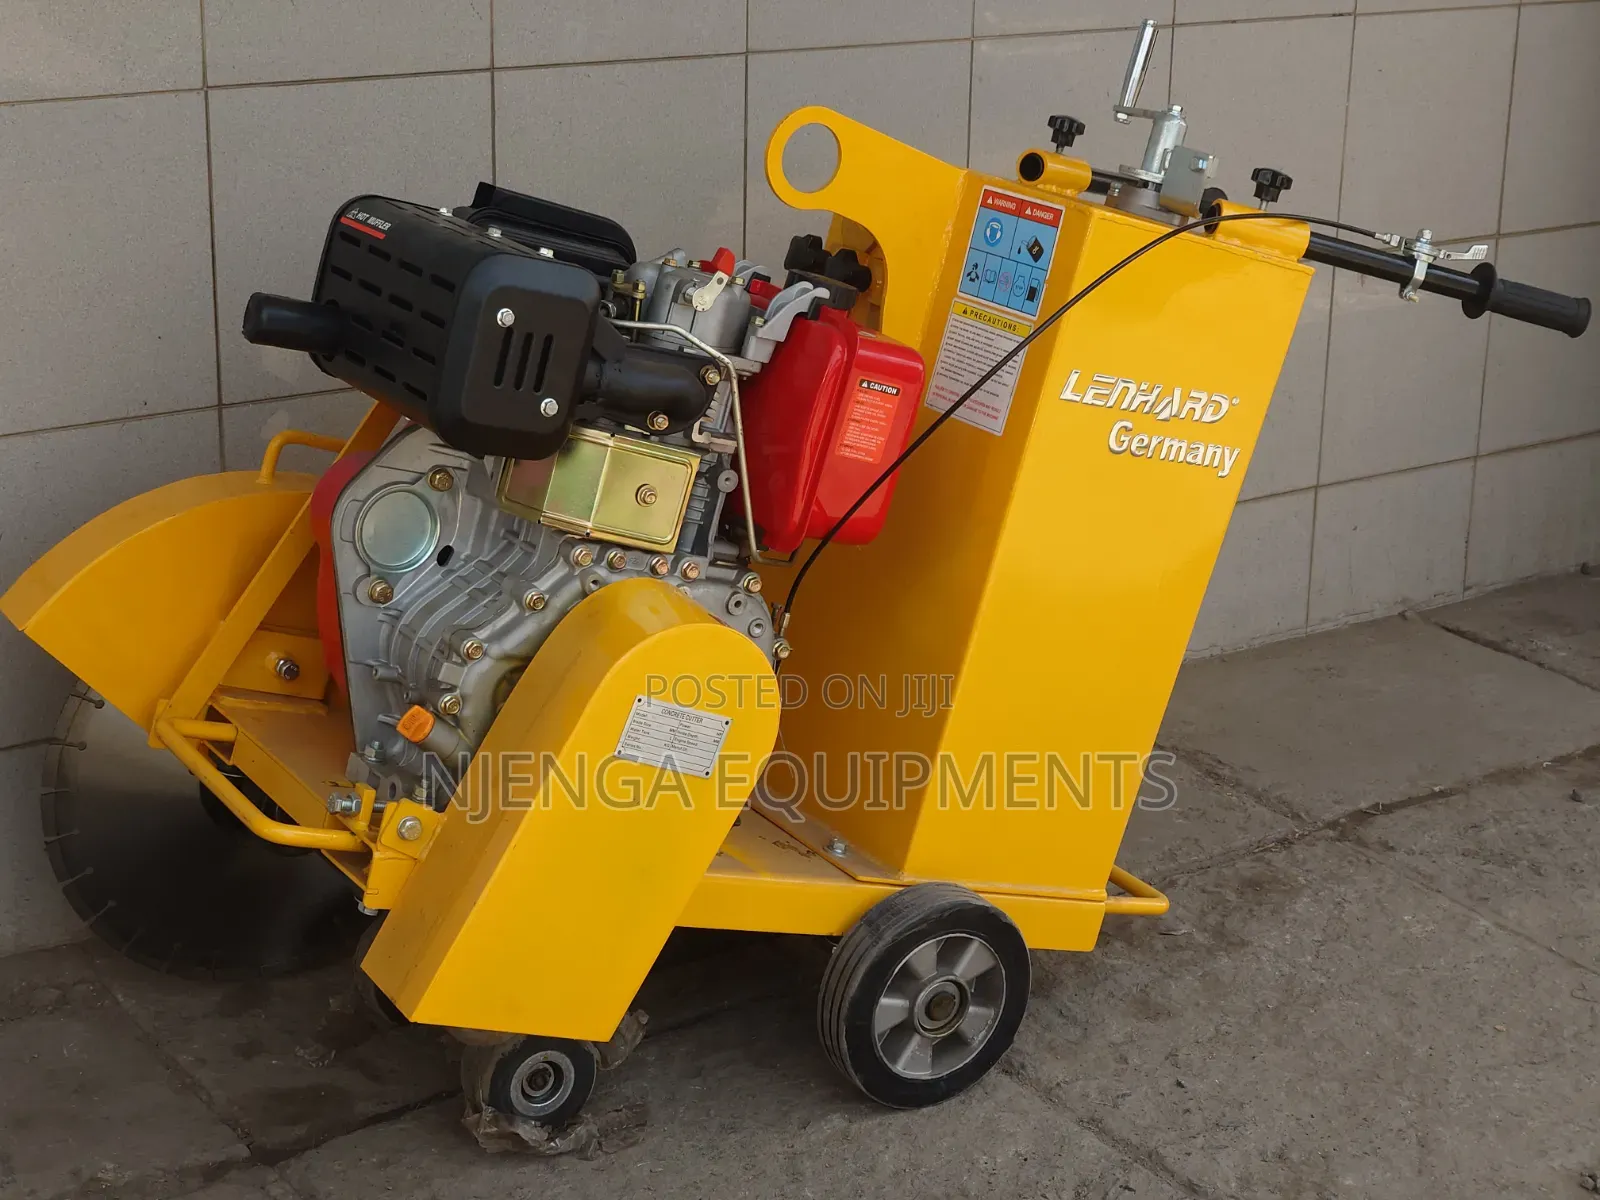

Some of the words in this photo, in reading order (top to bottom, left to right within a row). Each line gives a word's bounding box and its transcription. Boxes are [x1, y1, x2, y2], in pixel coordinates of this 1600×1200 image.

[993, 198, 1017, 211] WARNING
[356, 211, 370, 222] HOT
[367, 216, 392, 231] MUFFLER
[1032, 208, 1055, 221] DANGER
[969, 309, 1020, 333] PRECAUTIONS:
[869, 382, 898, 395] CAUTION
[1108, 420, 1241, 478] Germany
[661, 708, 687, 721] CONCRETE
[685, 714, 704, 724] CUTTER
